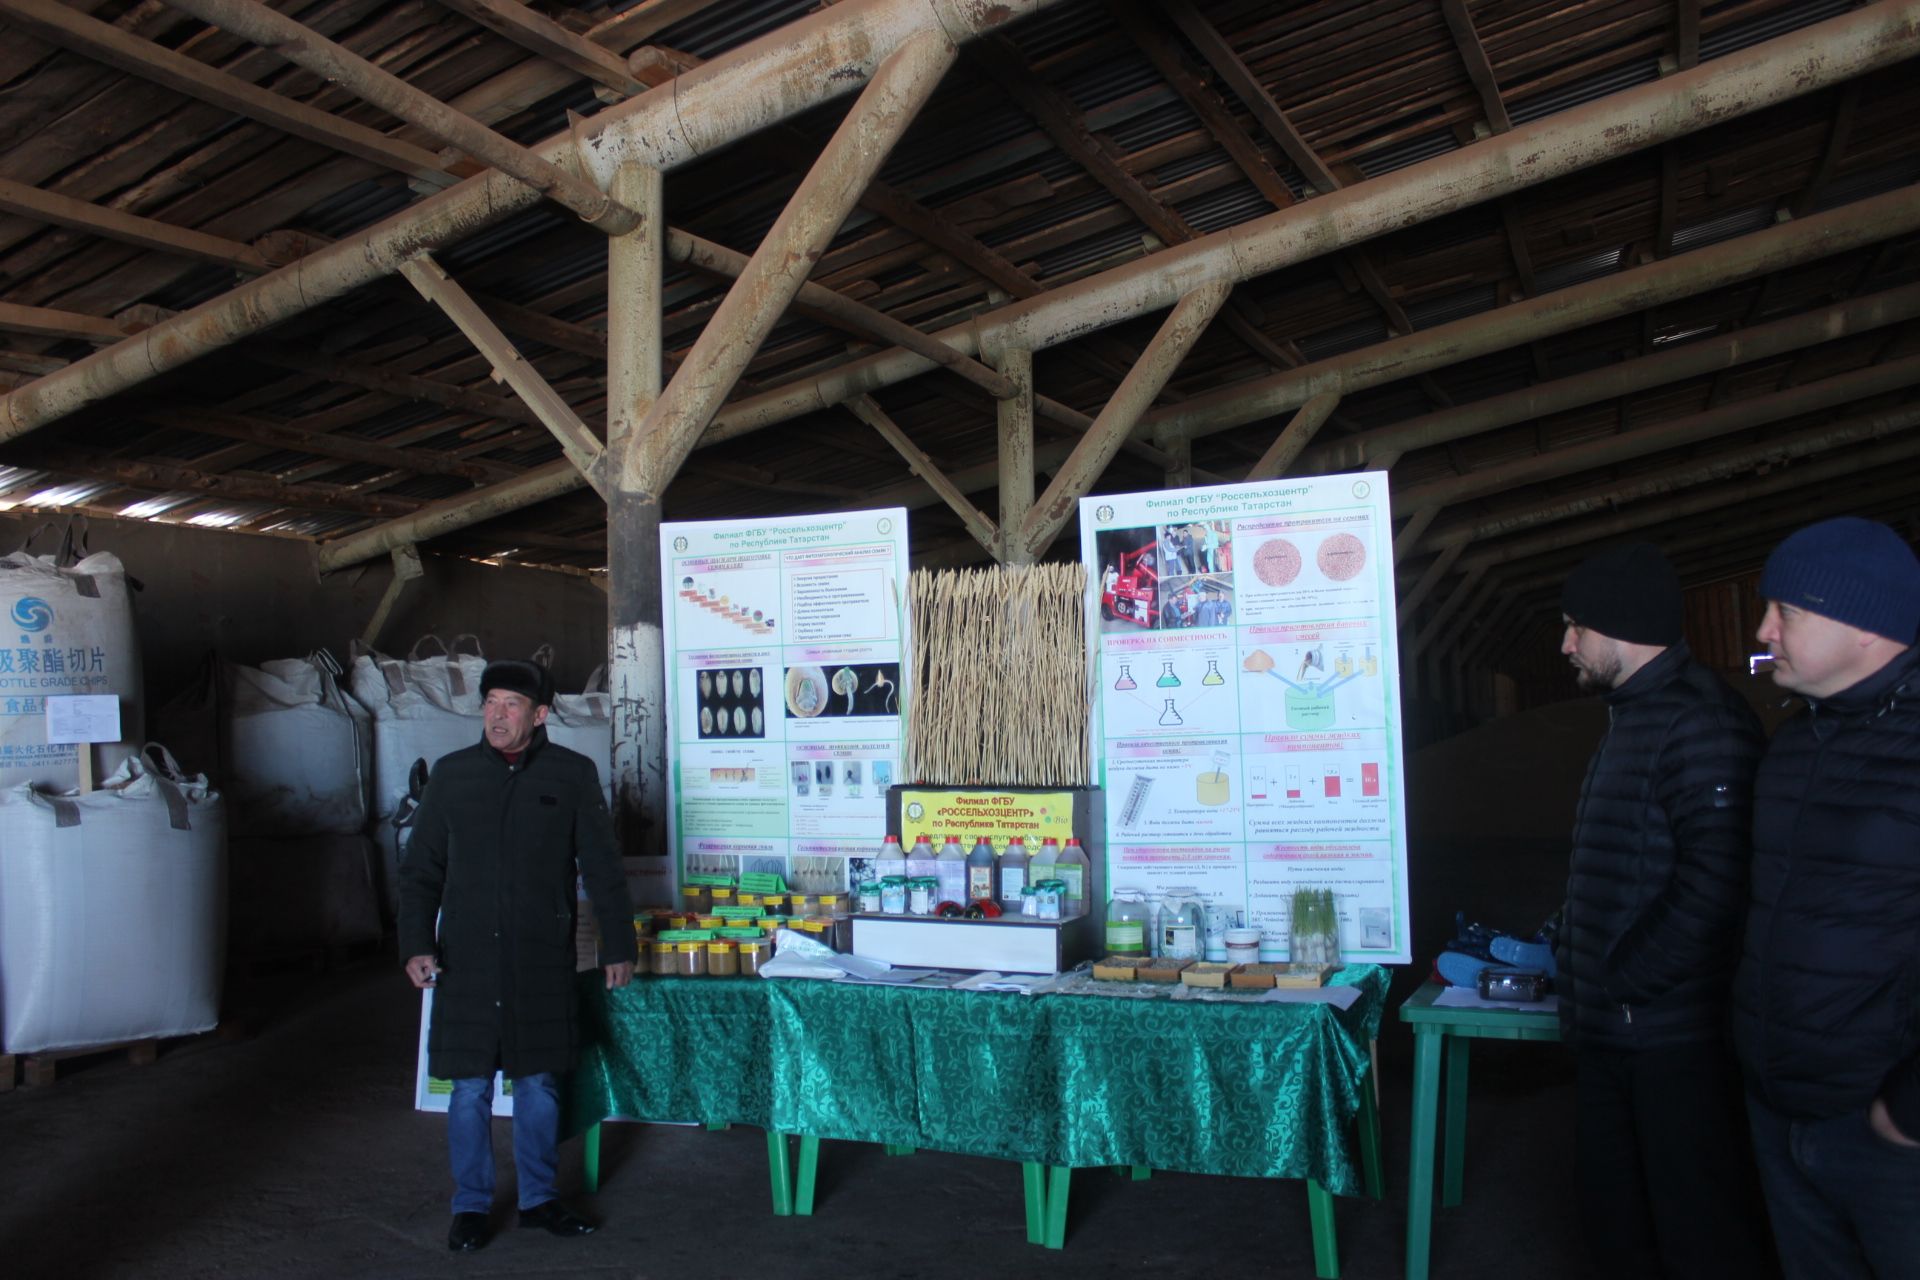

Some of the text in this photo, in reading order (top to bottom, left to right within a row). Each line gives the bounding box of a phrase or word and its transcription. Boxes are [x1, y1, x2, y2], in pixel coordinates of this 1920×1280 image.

[1146, 498, 1184, 509] Филиал
[1186, 494, 1214, 504] ФГБУ
[1167, 500, 1292, 518] по Республике Татарстан
[713, 530, 744, 541] Филиал
[744, 528, 767, 538] ФГБУ
[741, 538, 788, 550] Республике
[790, 534, 830, 545] Татарстан
[1107, 638, 1145, 647] ПРОВЕРКА
[1158, 633, 1228, 643] СОВМЕСТИМОСТЬ
[40, 676, 78, 688] GRADE
[79, 675, 108, 686] CHIPS
[956, 796, 1016, 806] Филиал ФГБУ
[937, 808, 1034, 819] «РОССЕЛЬХОЗЦЕНТР»
[944, 820, 994, 830] Республике
[996, 820, 1040, 830] Татарстан
